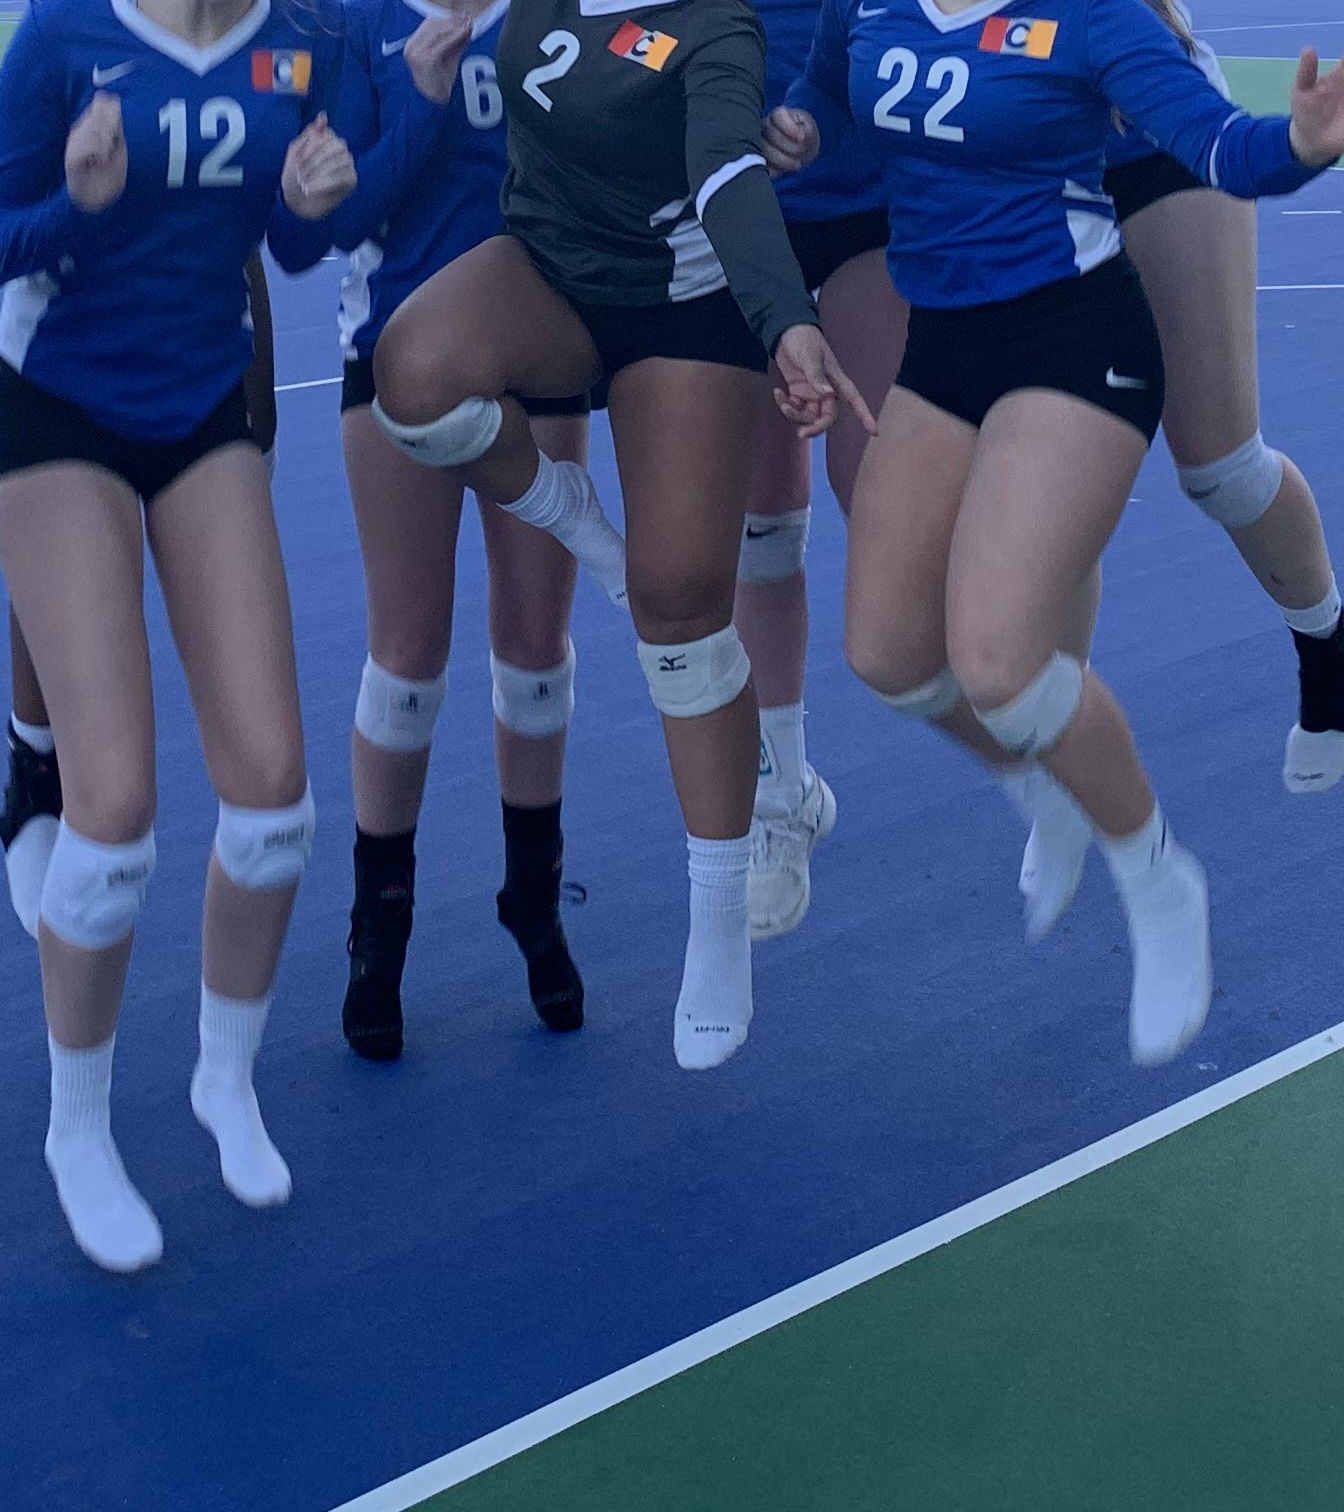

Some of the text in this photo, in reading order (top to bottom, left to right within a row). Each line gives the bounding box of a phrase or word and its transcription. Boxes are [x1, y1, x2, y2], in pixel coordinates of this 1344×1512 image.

[461, 54, 503, 128] 6
[522, 29, 580, 112] 2
[874, 46, 969, 143] 22
[158, 96, 246, 188] 12
